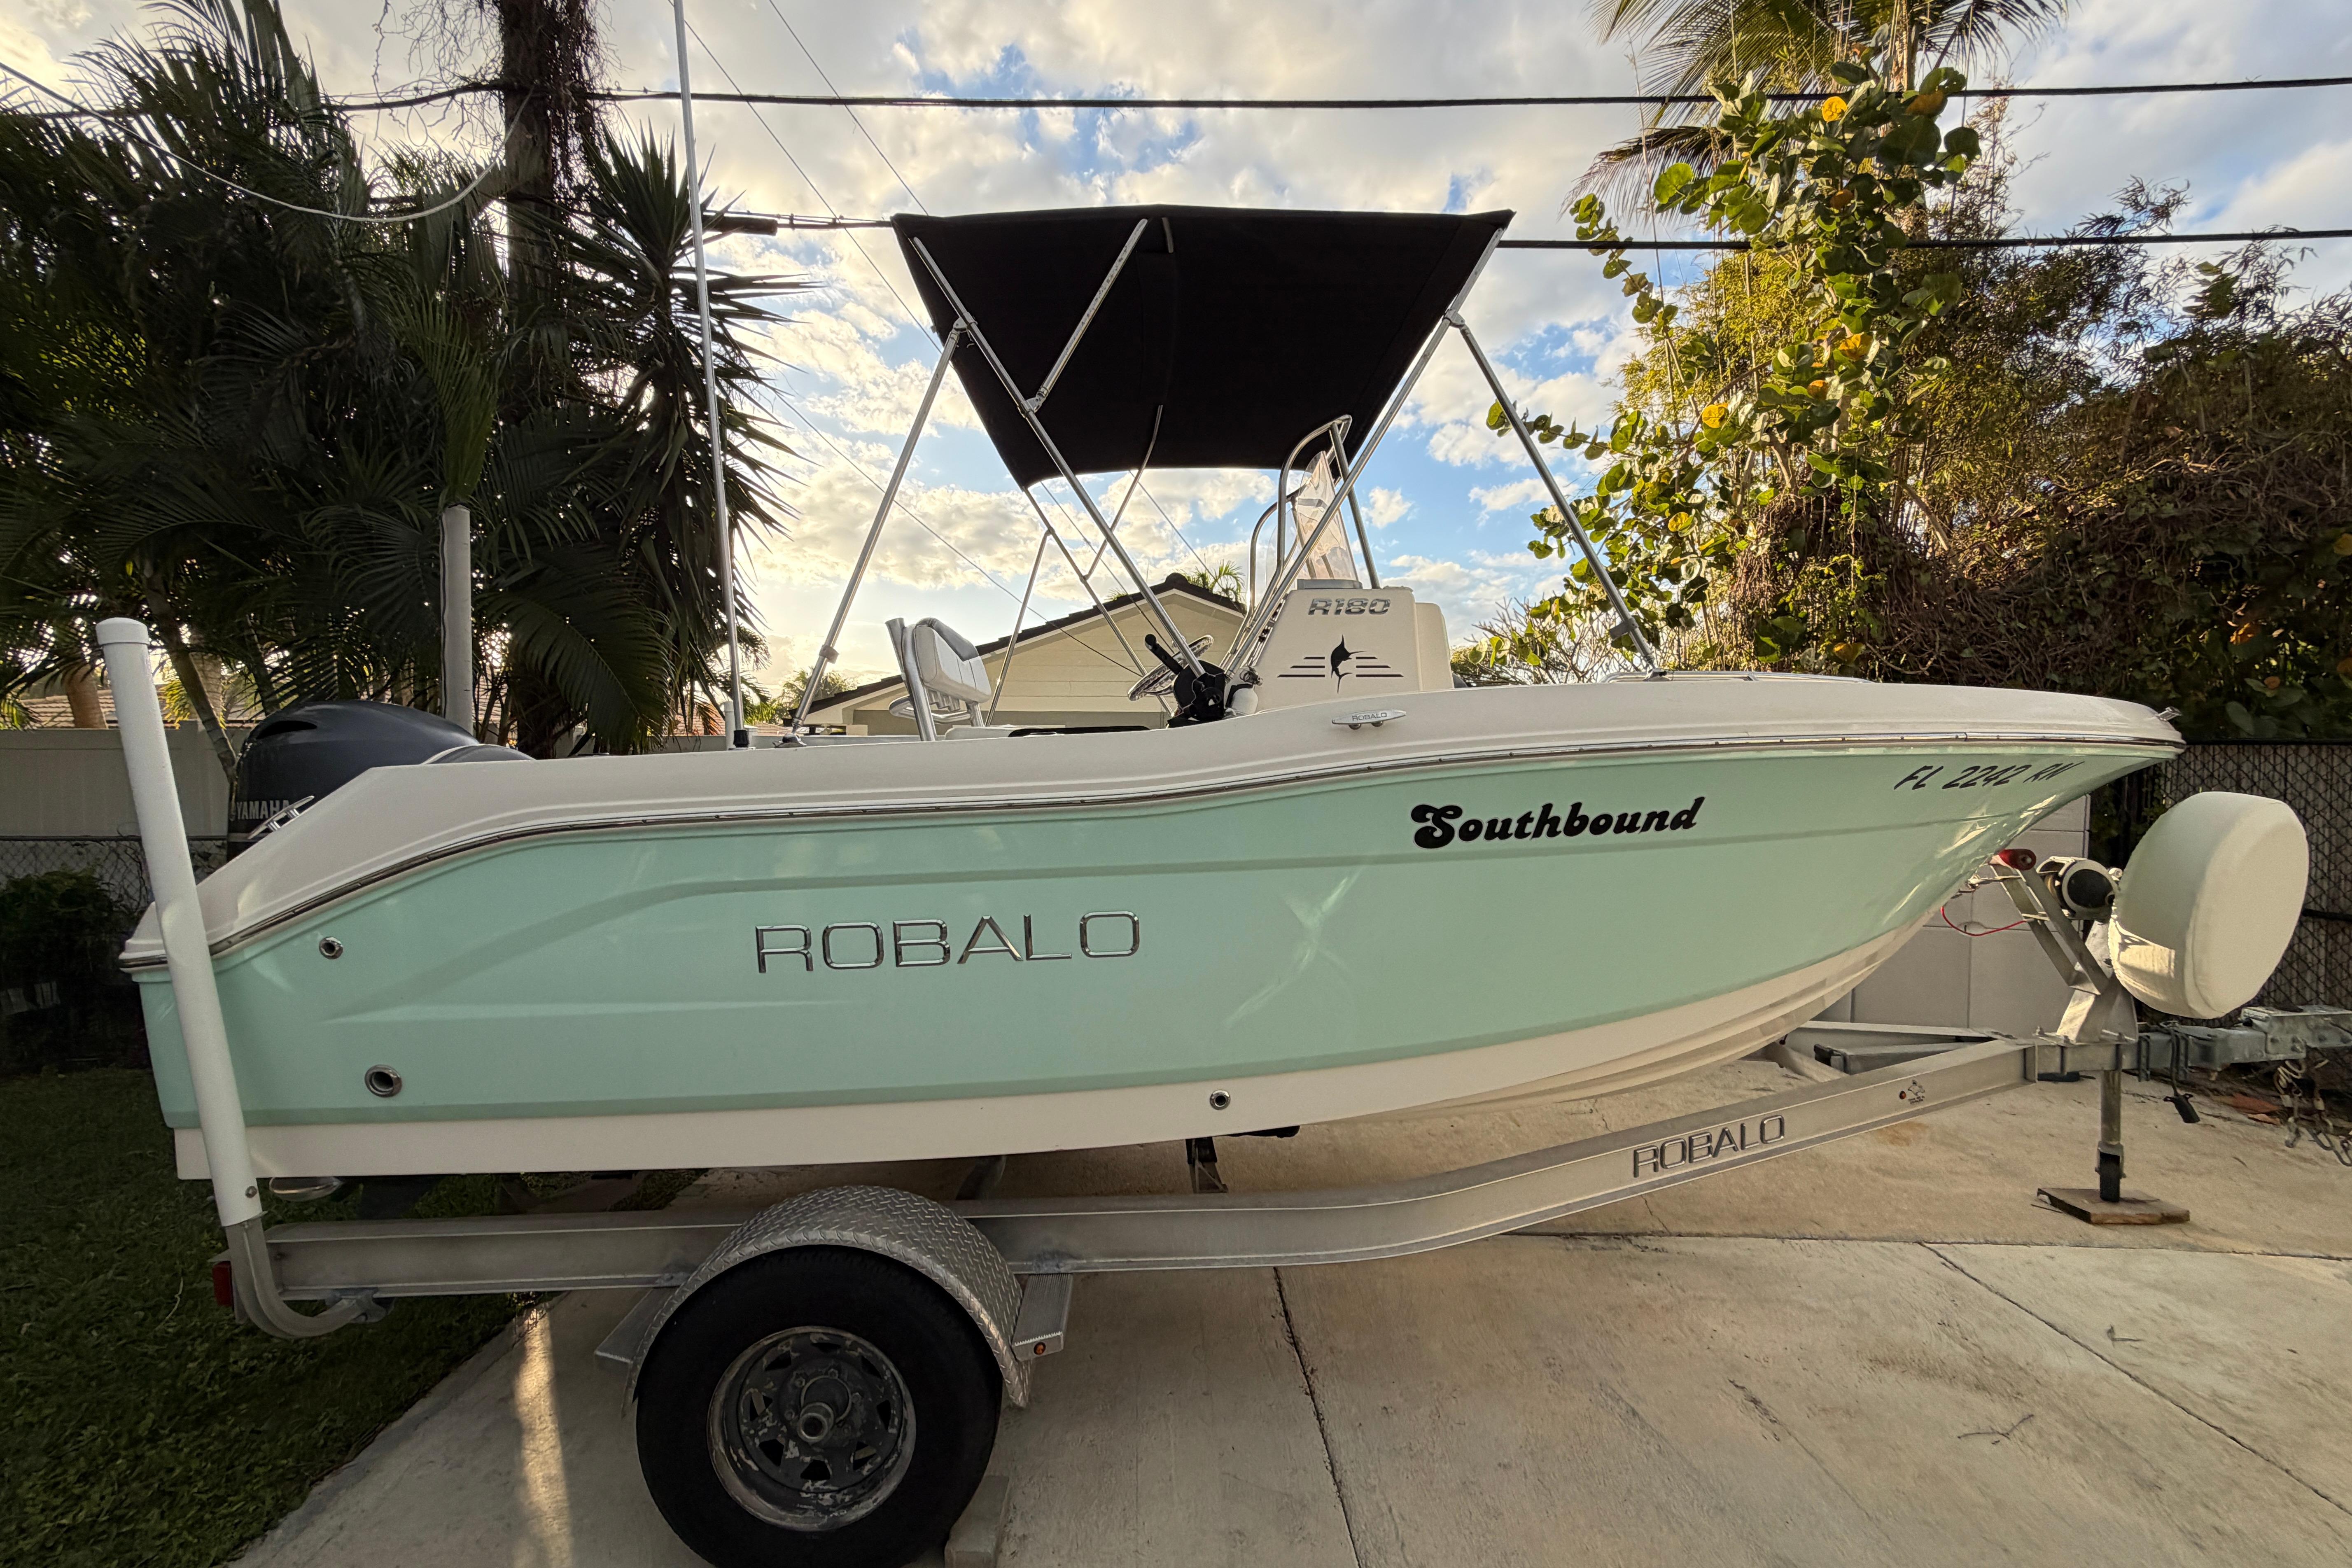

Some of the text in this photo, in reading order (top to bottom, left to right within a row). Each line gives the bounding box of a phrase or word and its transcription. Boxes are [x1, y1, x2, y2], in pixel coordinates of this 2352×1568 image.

[1308, 598, 1391, 615] R180
[1352, 712, 1387, 721] ROBALO
[1894, 765, 1944, 790] FL
[1941, 764, 2032, 790] 2242
[1410, 796, 1706, 849] Southbound
[755, 910, 1140, 973] ROBALO
[1633, 1114, 1785, 1178] ROBALO
